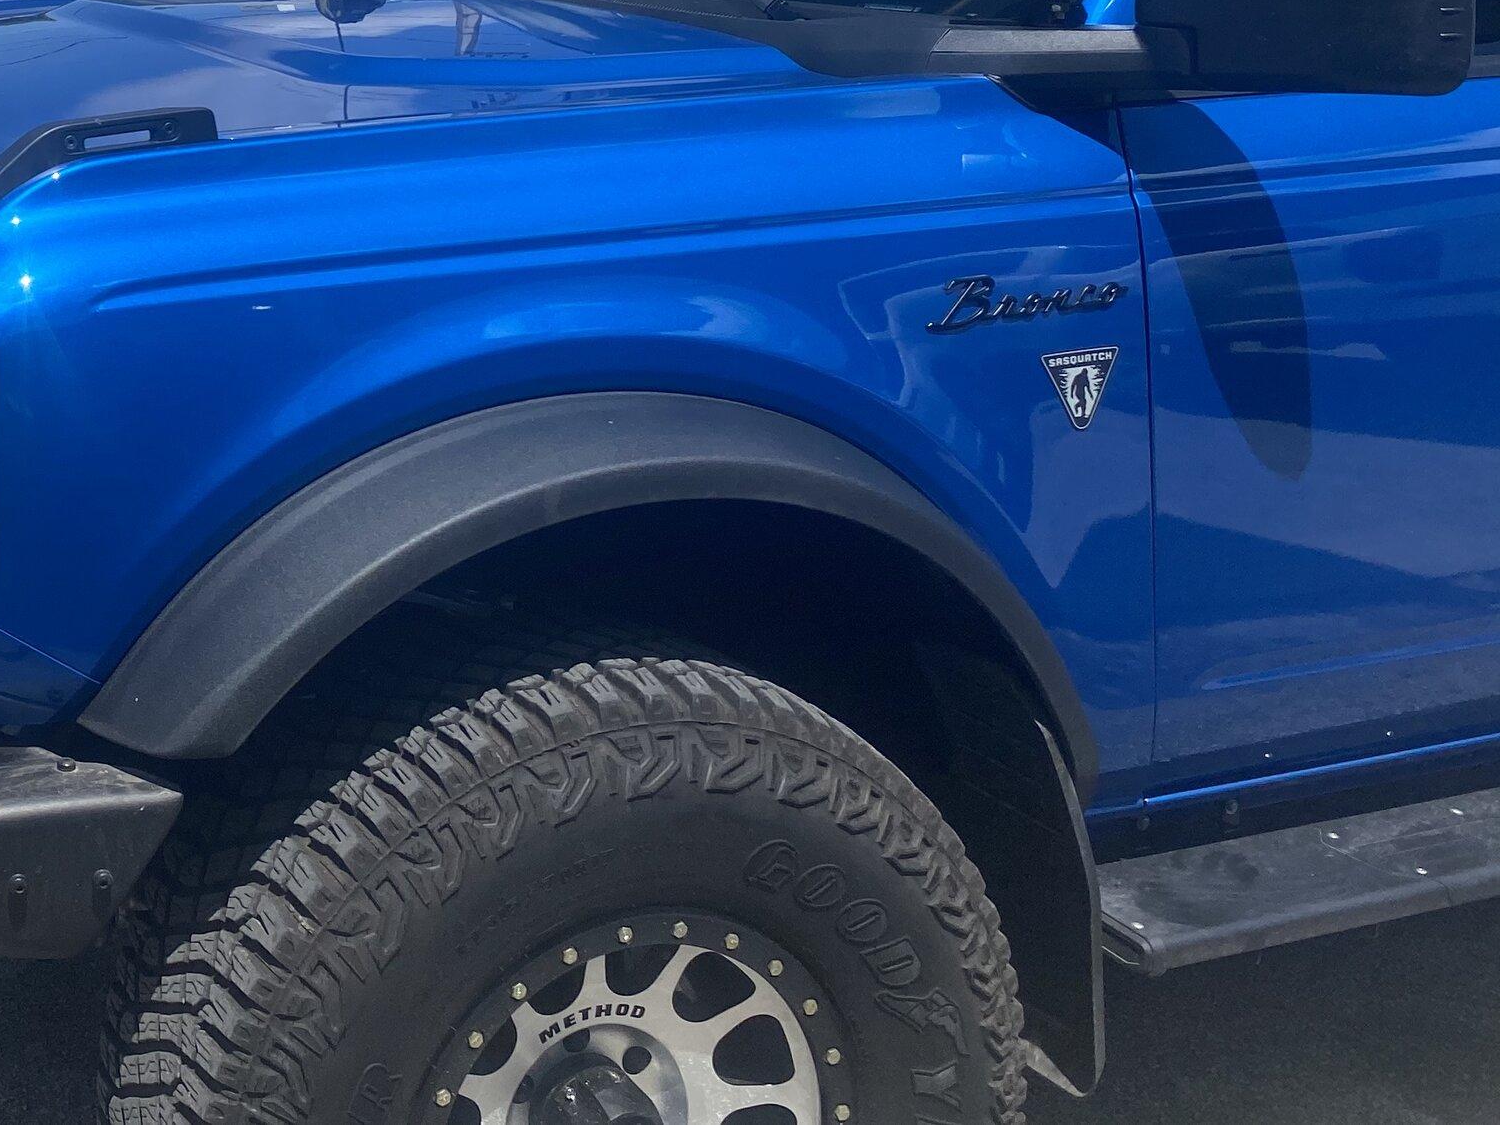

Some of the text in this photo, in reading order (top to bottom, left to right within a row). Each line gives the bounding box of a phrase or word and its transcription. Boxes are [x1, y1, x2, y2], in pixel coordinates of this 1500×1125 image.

[925, 274, 1128, 335] Bronco
[1048, 351, 1113, 367] SASQUATCH
[538, 1002, 646, 1045] METHOD
